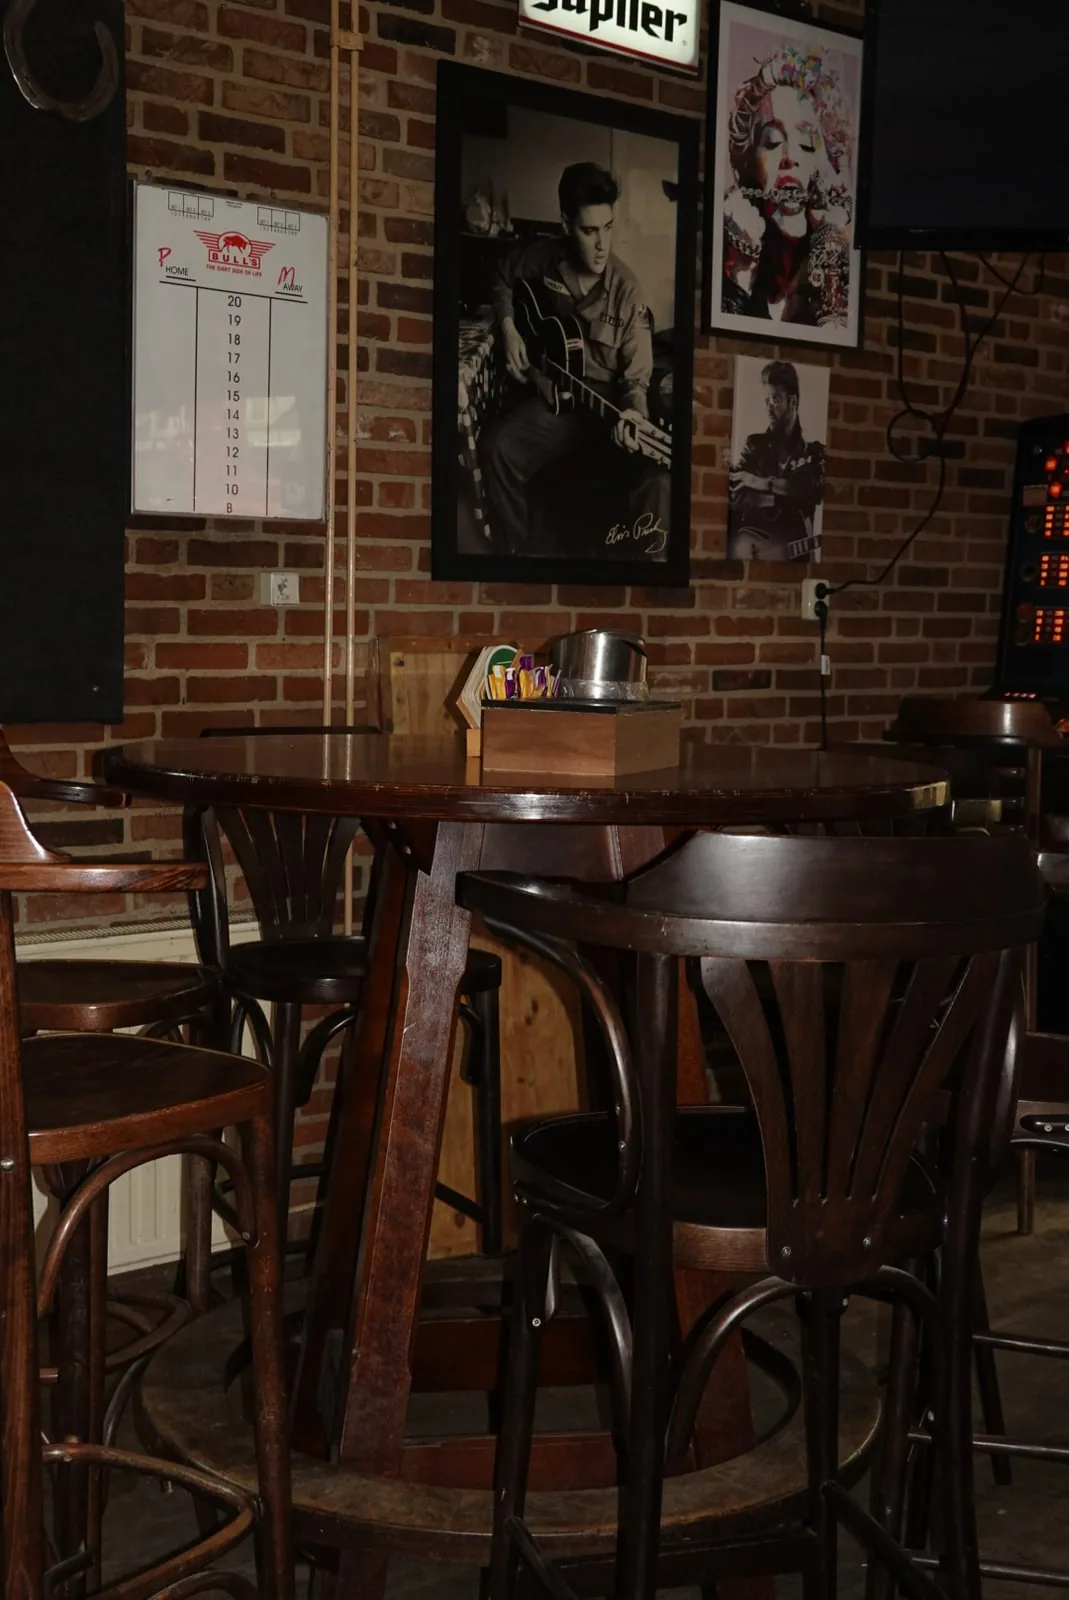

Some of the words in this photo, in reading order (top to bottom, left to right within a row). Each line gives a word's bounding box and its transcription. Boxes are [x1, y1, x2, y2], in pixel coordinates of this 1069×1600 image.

[532, 0, 688, 42] piler
[165, 264, 189, 276] HOME
[283, 282, 303, 292] AWAY
[228, 295, 242, 308] 20
[228, 314, 241, 326] 19
[228, 333, 241, 346] 18
[228, 352, 241, 364] 17
[228, 371, 240, 383] 16
[227, 389, 240, 402] 15
[226, 408, 239, 420] 14
[226, 427, 239, 439] 13
[226, 446, 239, 458] 12
[226, 465, 237, 476] 11
[225, 483, 239, 495] 10
